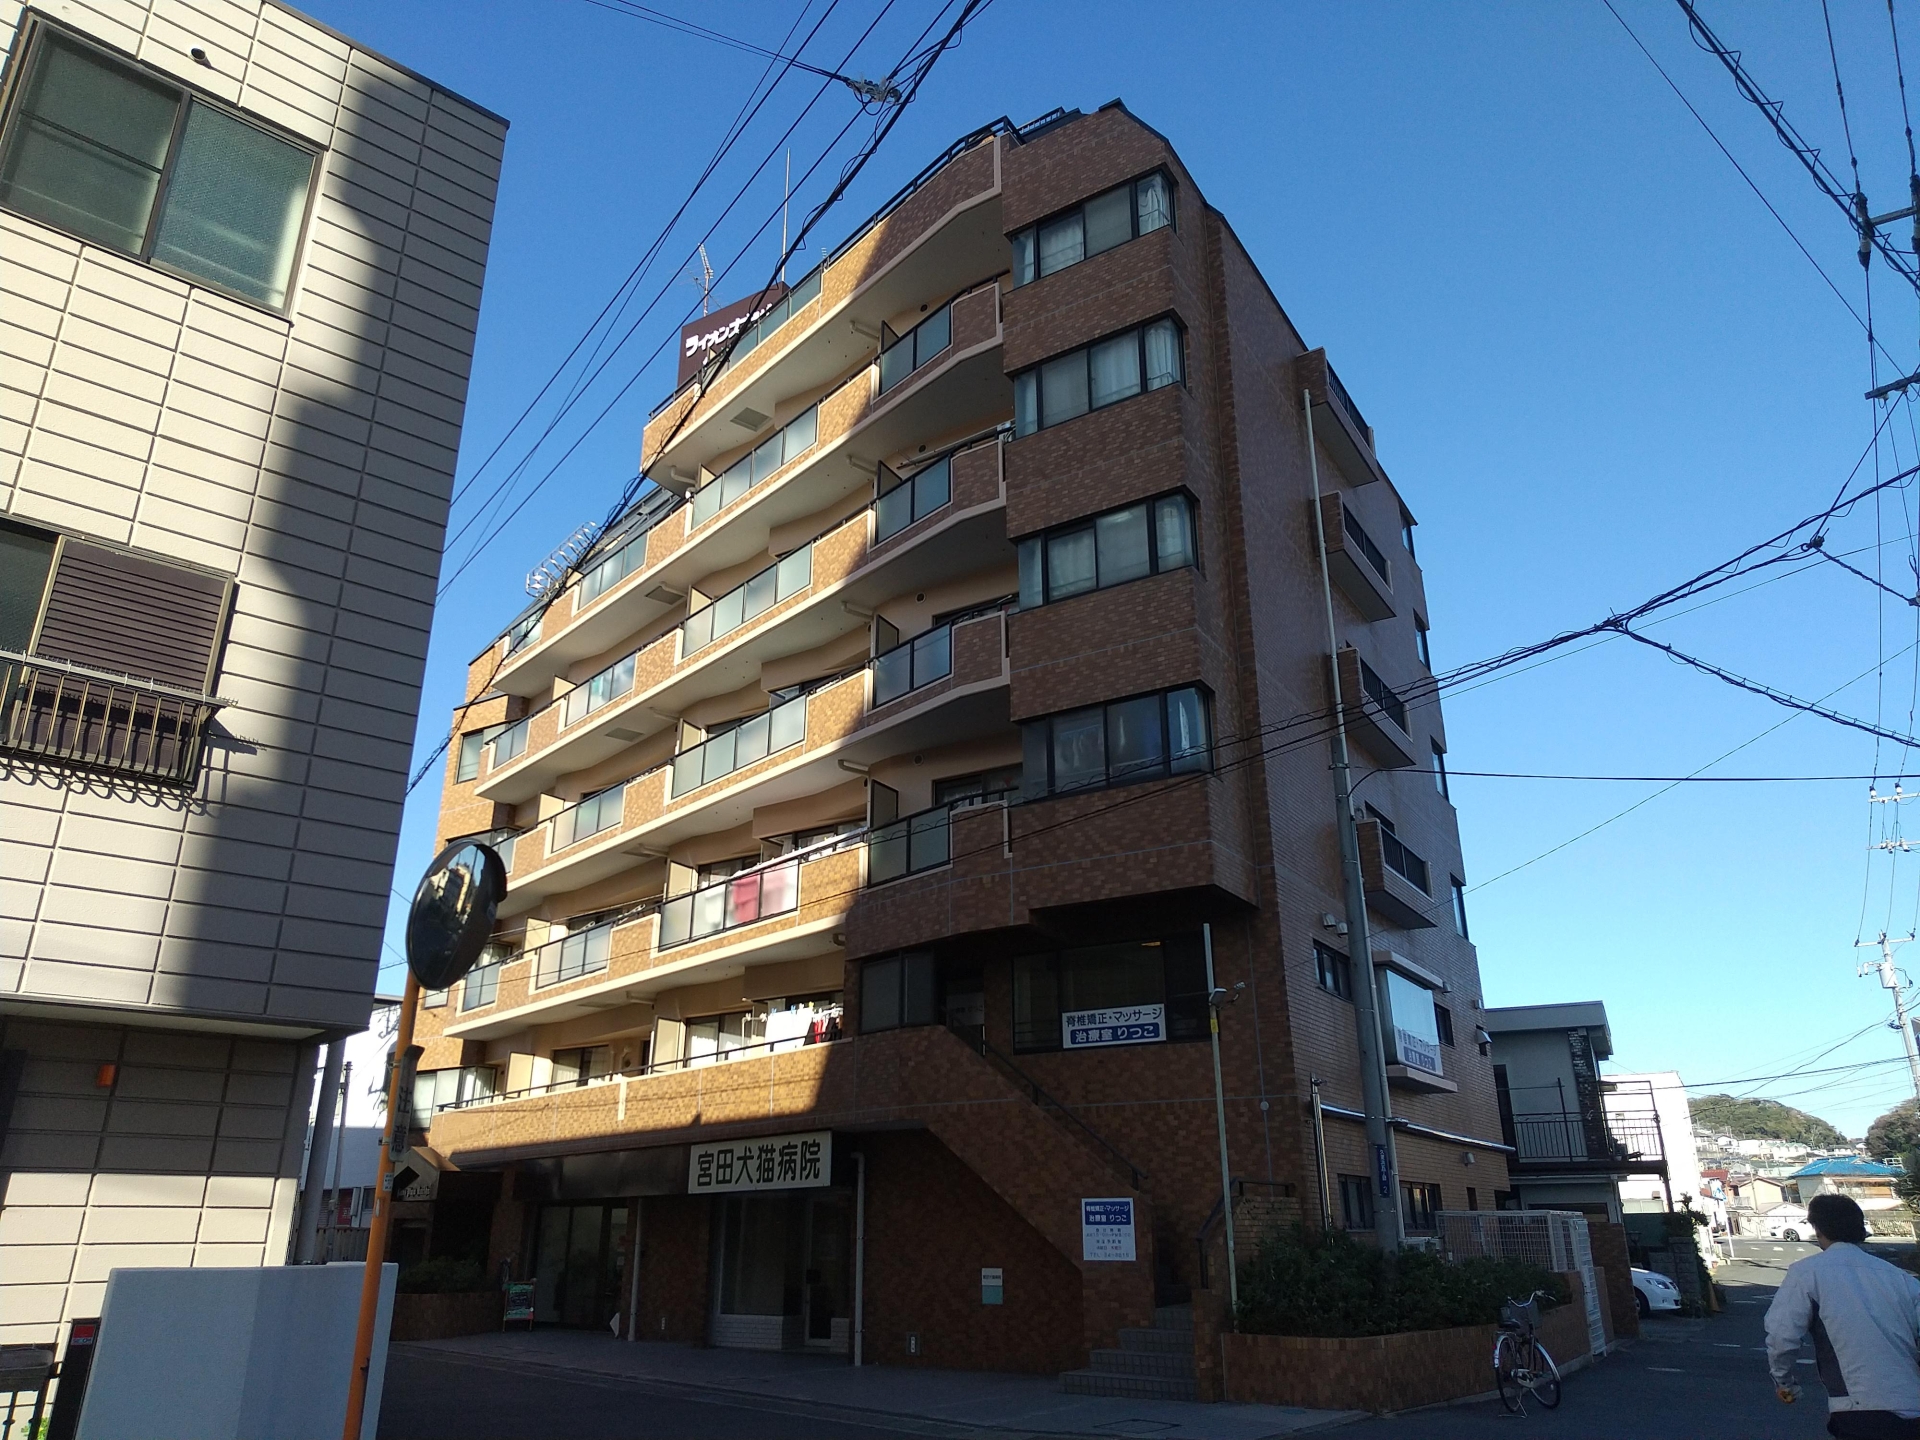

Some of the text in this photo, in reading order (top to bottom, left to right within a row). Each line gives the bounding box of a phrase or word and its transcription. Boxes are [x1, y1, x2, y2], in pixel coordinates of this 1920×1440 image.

[1066, 1007, 1163, 1027] 脊椎矯正・マッサージ
[1075, 1025, 1155, 1043] 治療室 りつこ
[391, 1086, 412, 1153] 注意
[697, 1138, 821, 1187] 宮田犬猫病院
[1109, 1214, 1127, 1222] りつこ
